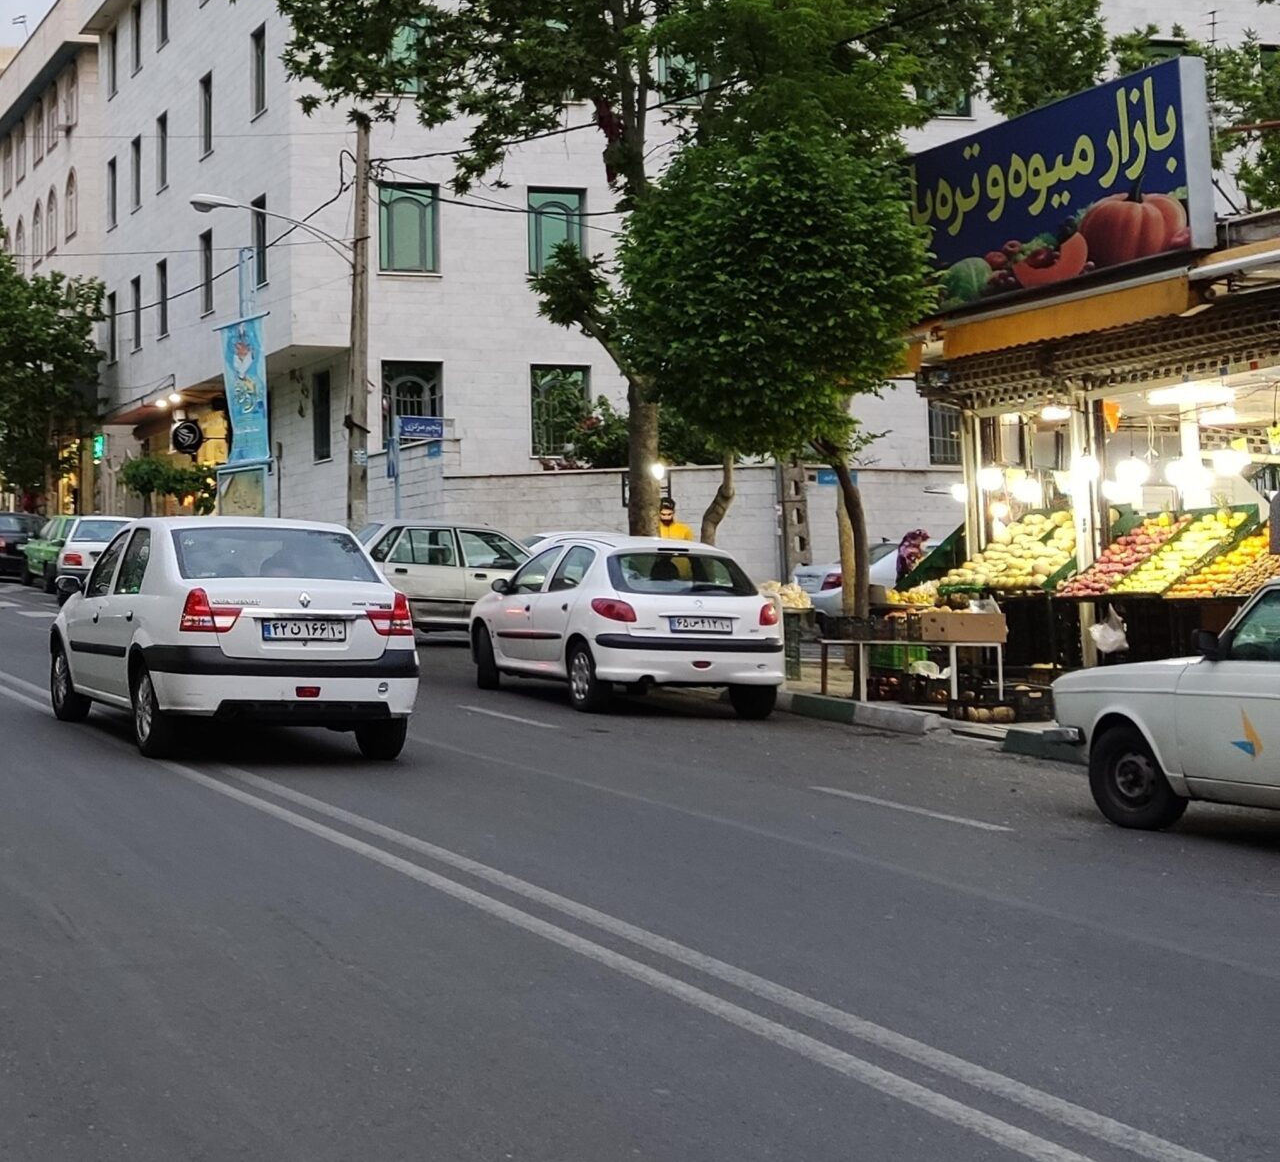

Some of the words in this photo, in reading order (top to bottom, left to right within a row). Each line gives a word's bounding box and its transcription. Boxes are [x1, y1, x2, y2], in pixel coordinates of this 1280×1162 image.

[1098, 76, 1177, 189] بازار
[909, 163, 933, 248] با
[986, 164, 1005, 222] و
[1008, 133, 1095, 216] میوه
[404, 422, 425, 432] مرکزی
